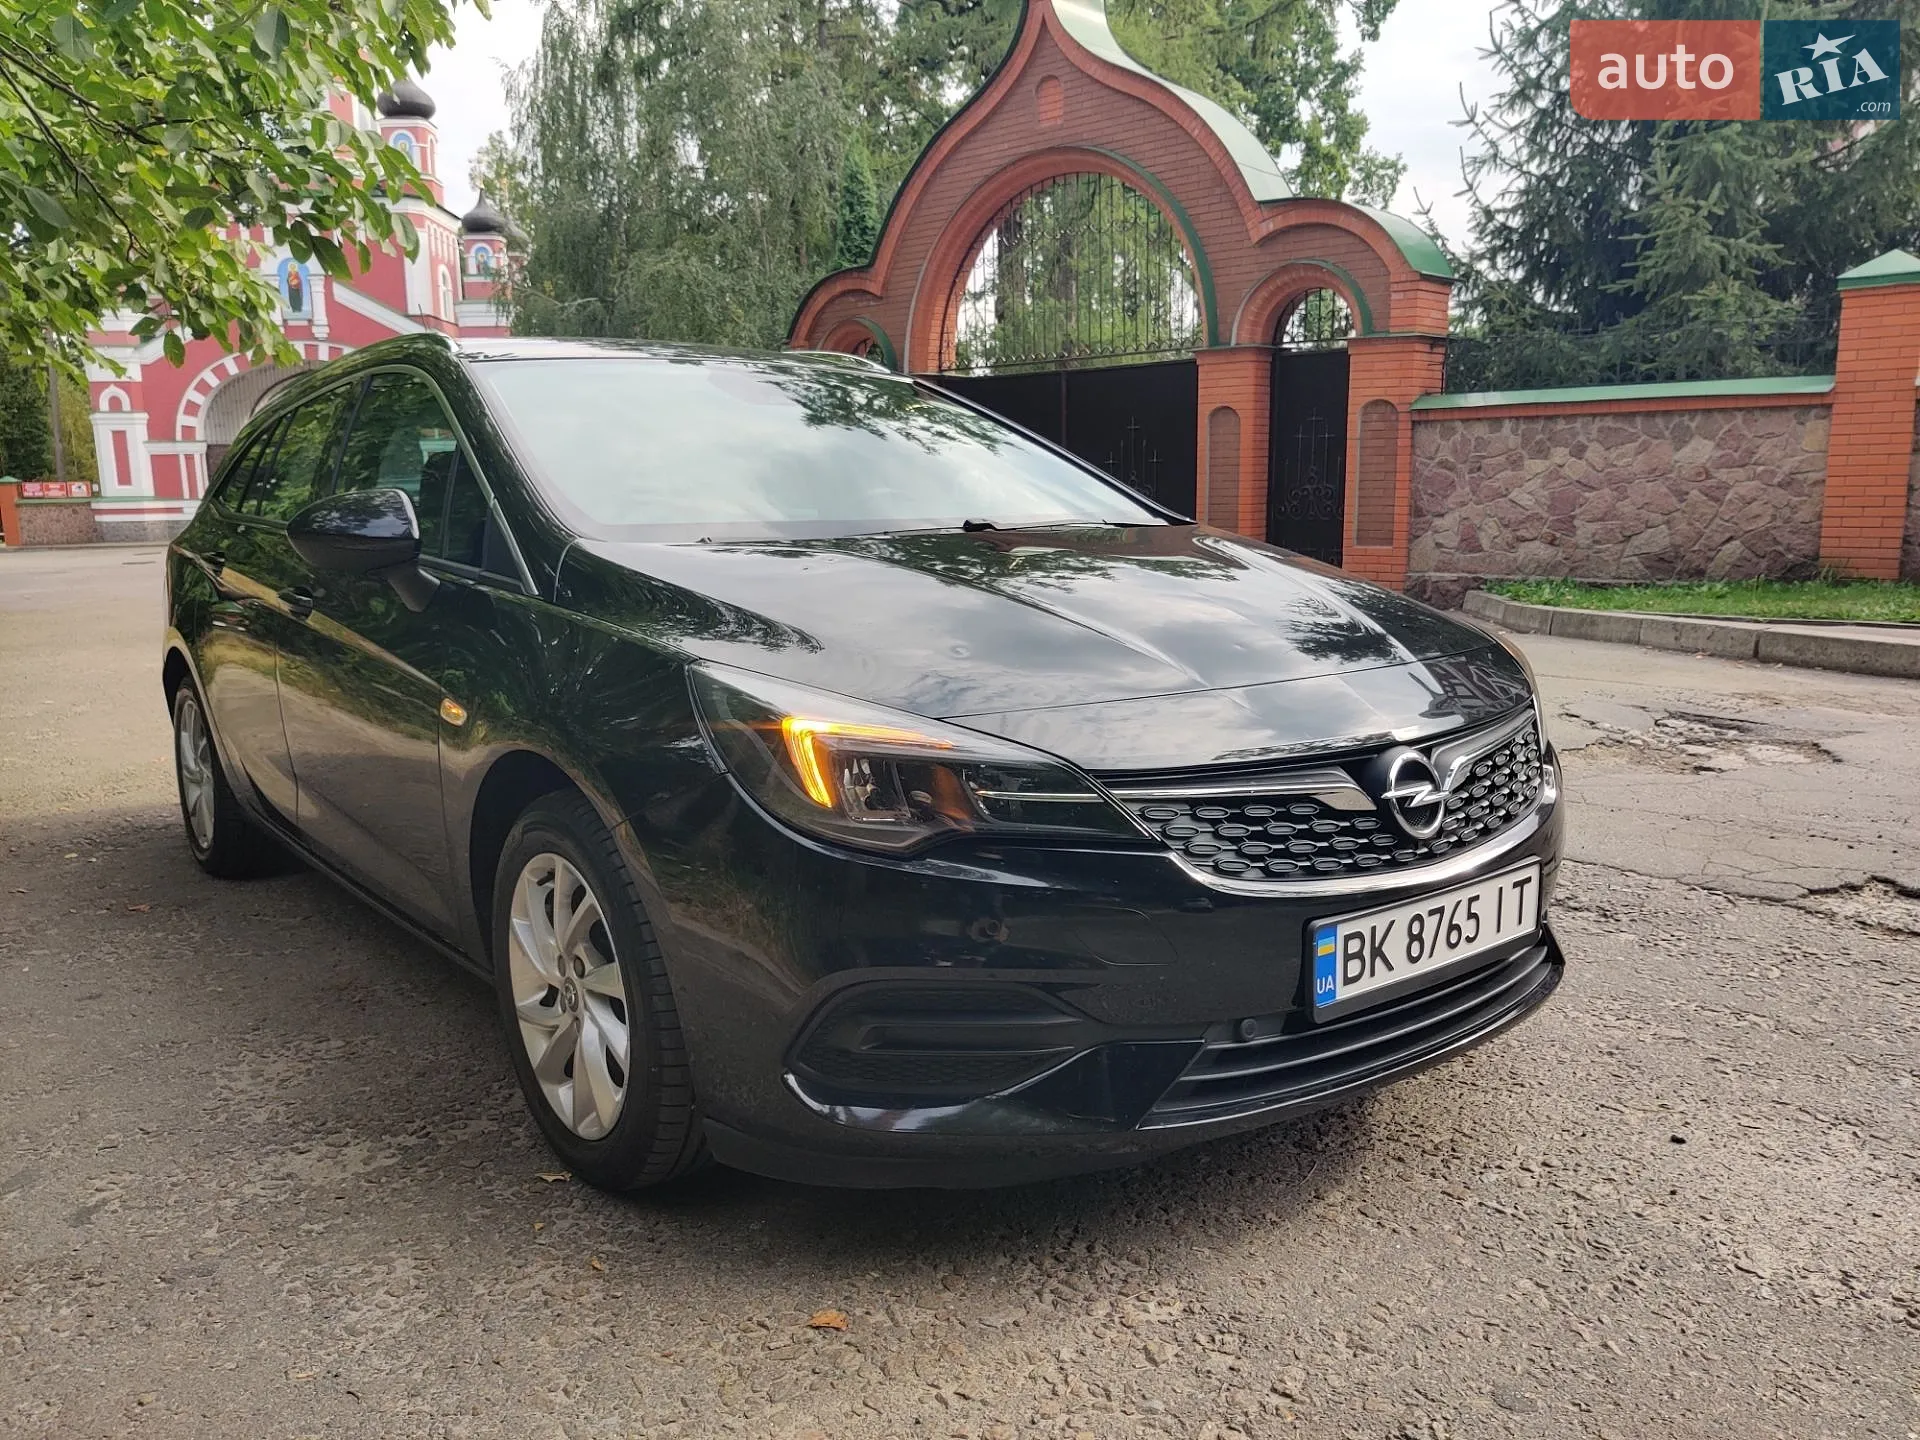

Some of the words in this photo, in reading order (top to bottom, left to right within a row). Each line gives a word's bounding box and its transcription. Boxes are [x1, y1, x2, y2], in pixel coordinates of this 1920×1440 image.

[1343, 919, 1396, 987] BK
[1406, 894, 1480, 965] 8765
[1316, 975, 1335, 994] UA
